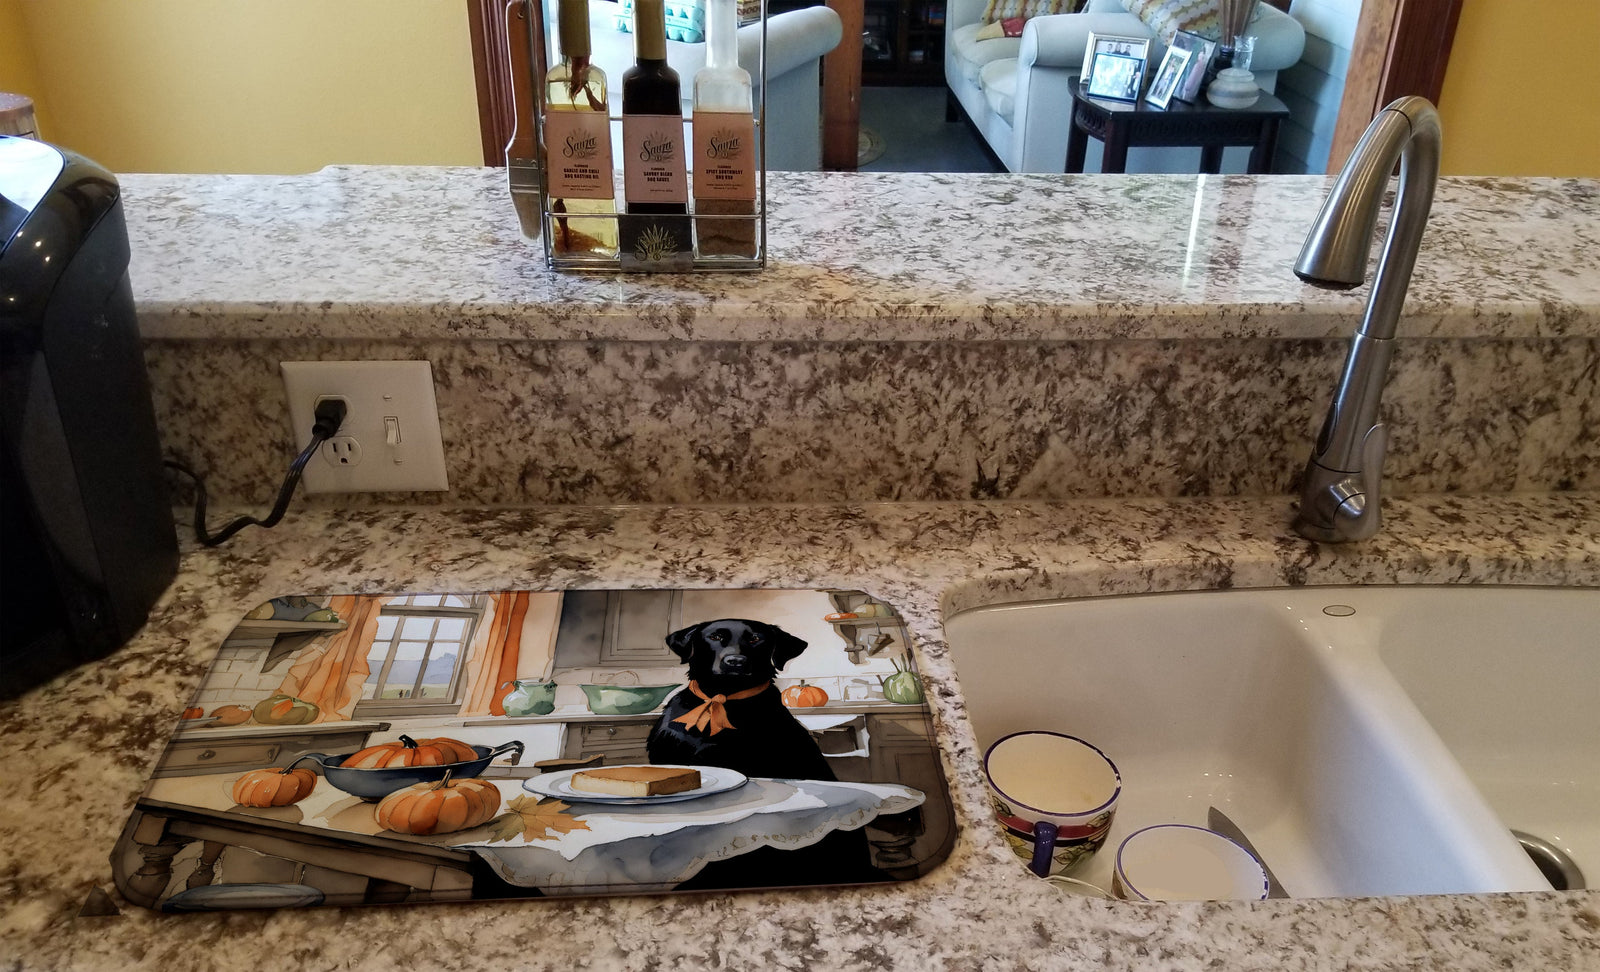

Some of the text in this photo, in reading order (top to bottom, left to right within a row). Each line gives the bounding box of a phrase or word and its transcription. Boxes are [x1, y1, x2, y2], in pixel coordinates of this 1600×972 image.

[563, 136, 598, 158] Sauza
[640, 140, 674, 161] Sauza
[706, 136, 740, 159] Sauza
